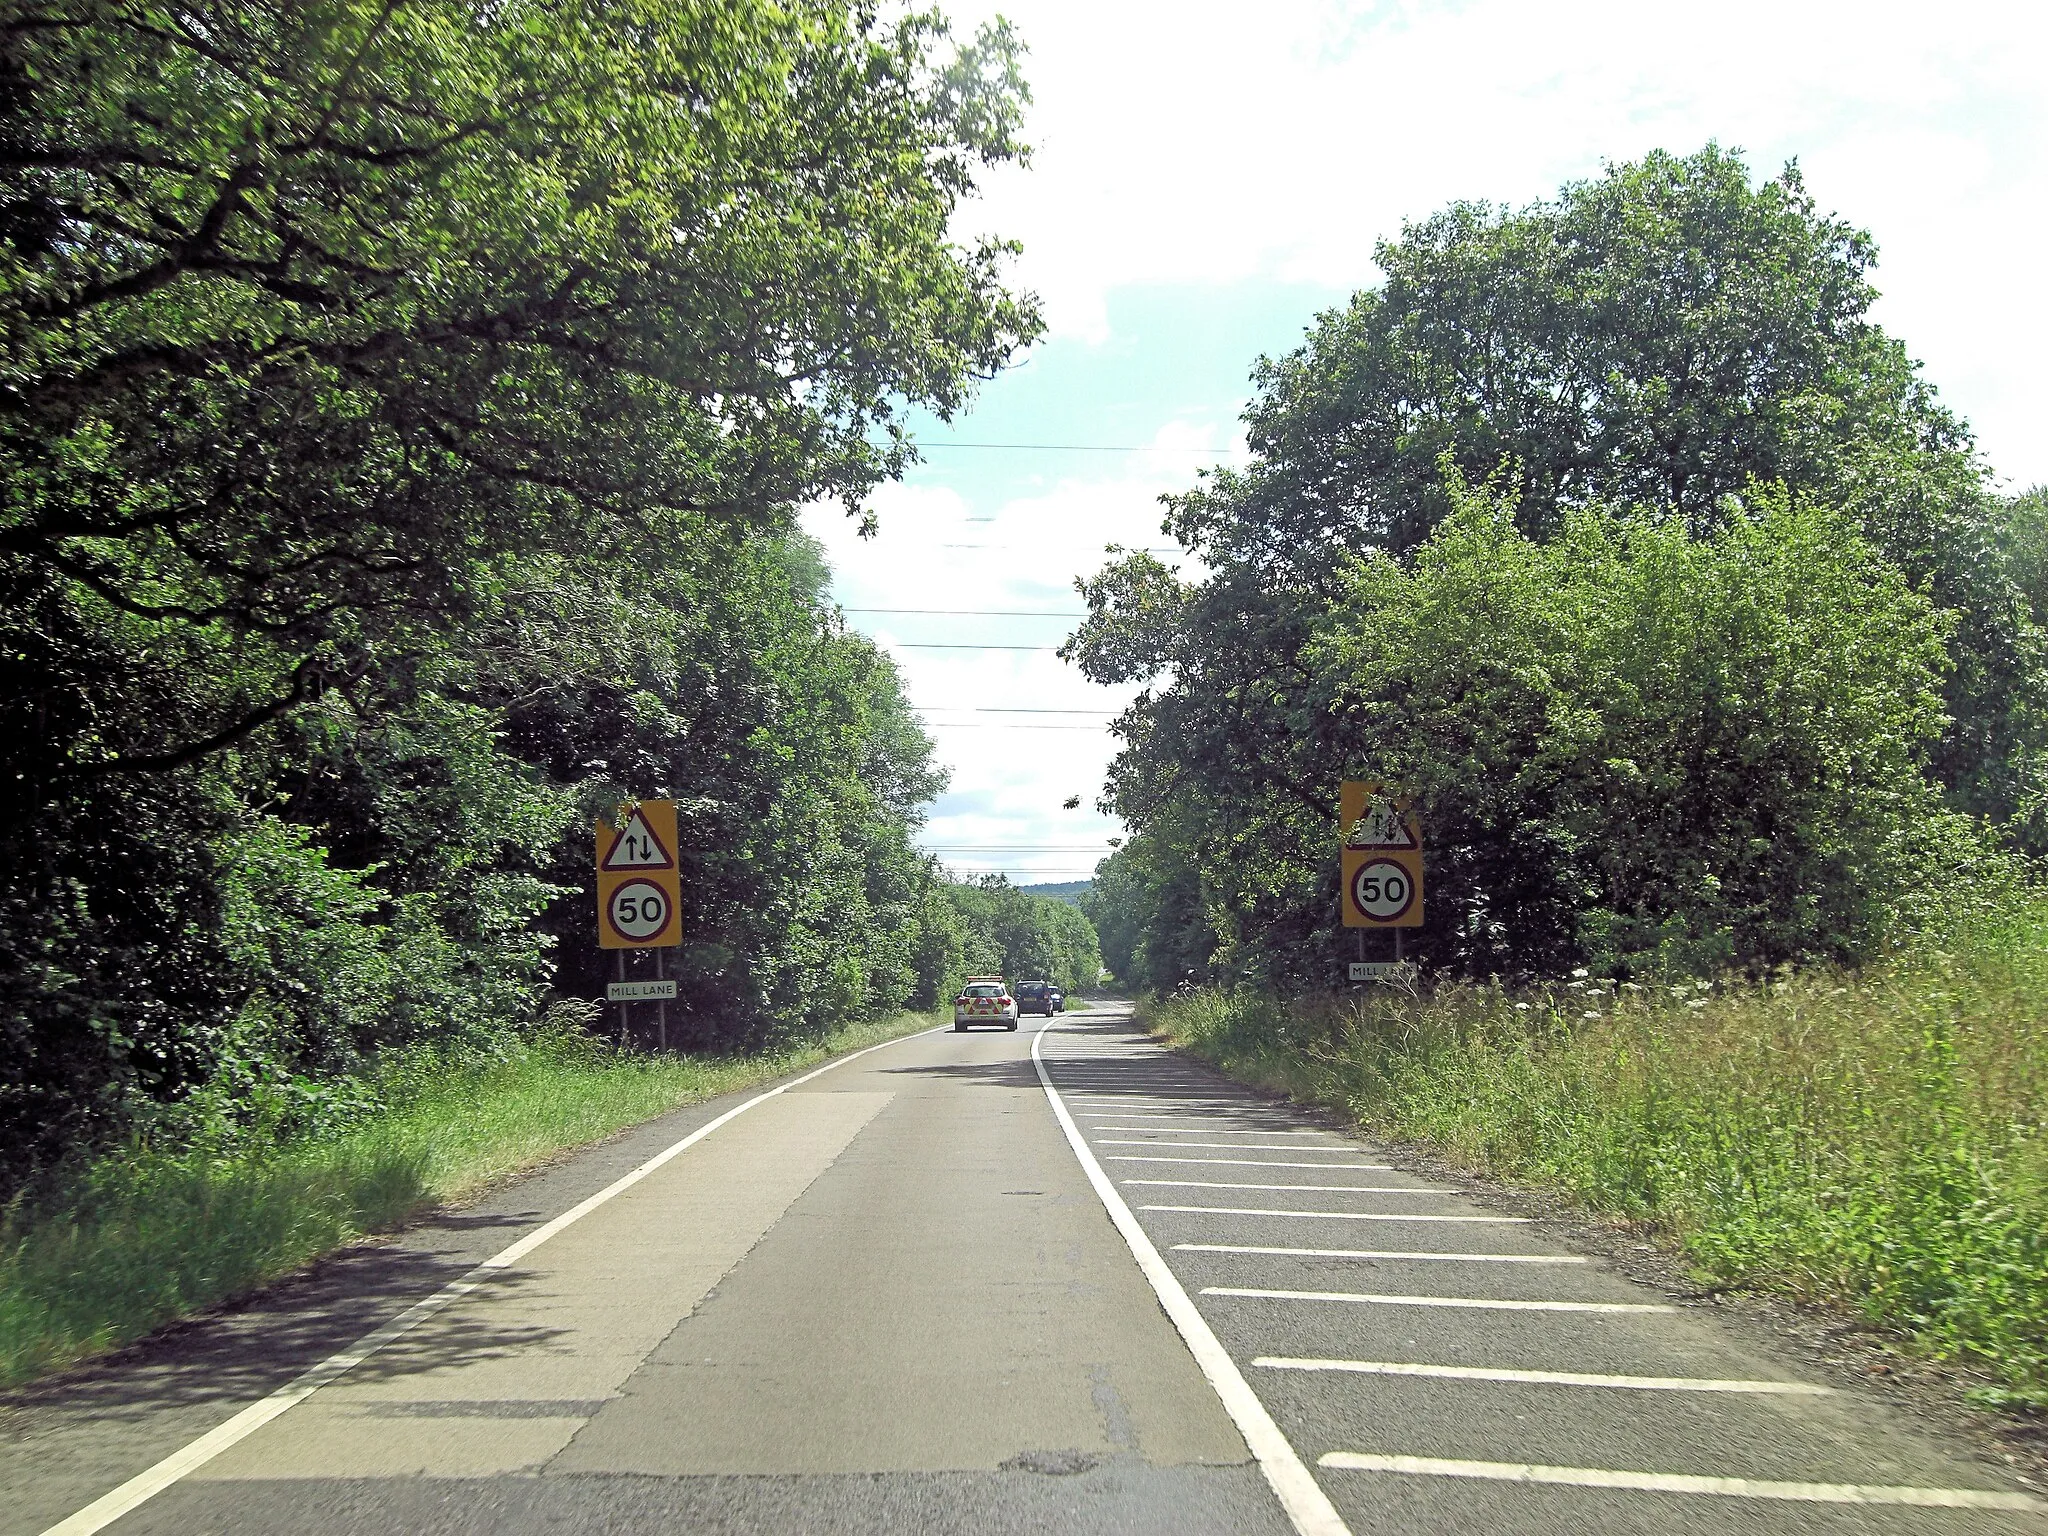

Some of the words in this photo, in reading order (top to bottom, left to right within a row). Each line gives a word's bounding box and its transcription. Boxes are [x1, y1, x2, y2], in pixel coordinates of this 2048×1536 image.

[1363, 877, 1404, 903] 50
[618, 896, 662, 923] 50
[1352, 967, 1378, 976] MILL
[611, 987, 638, 996] MILL
[642, 985, 673, 995] LANE
